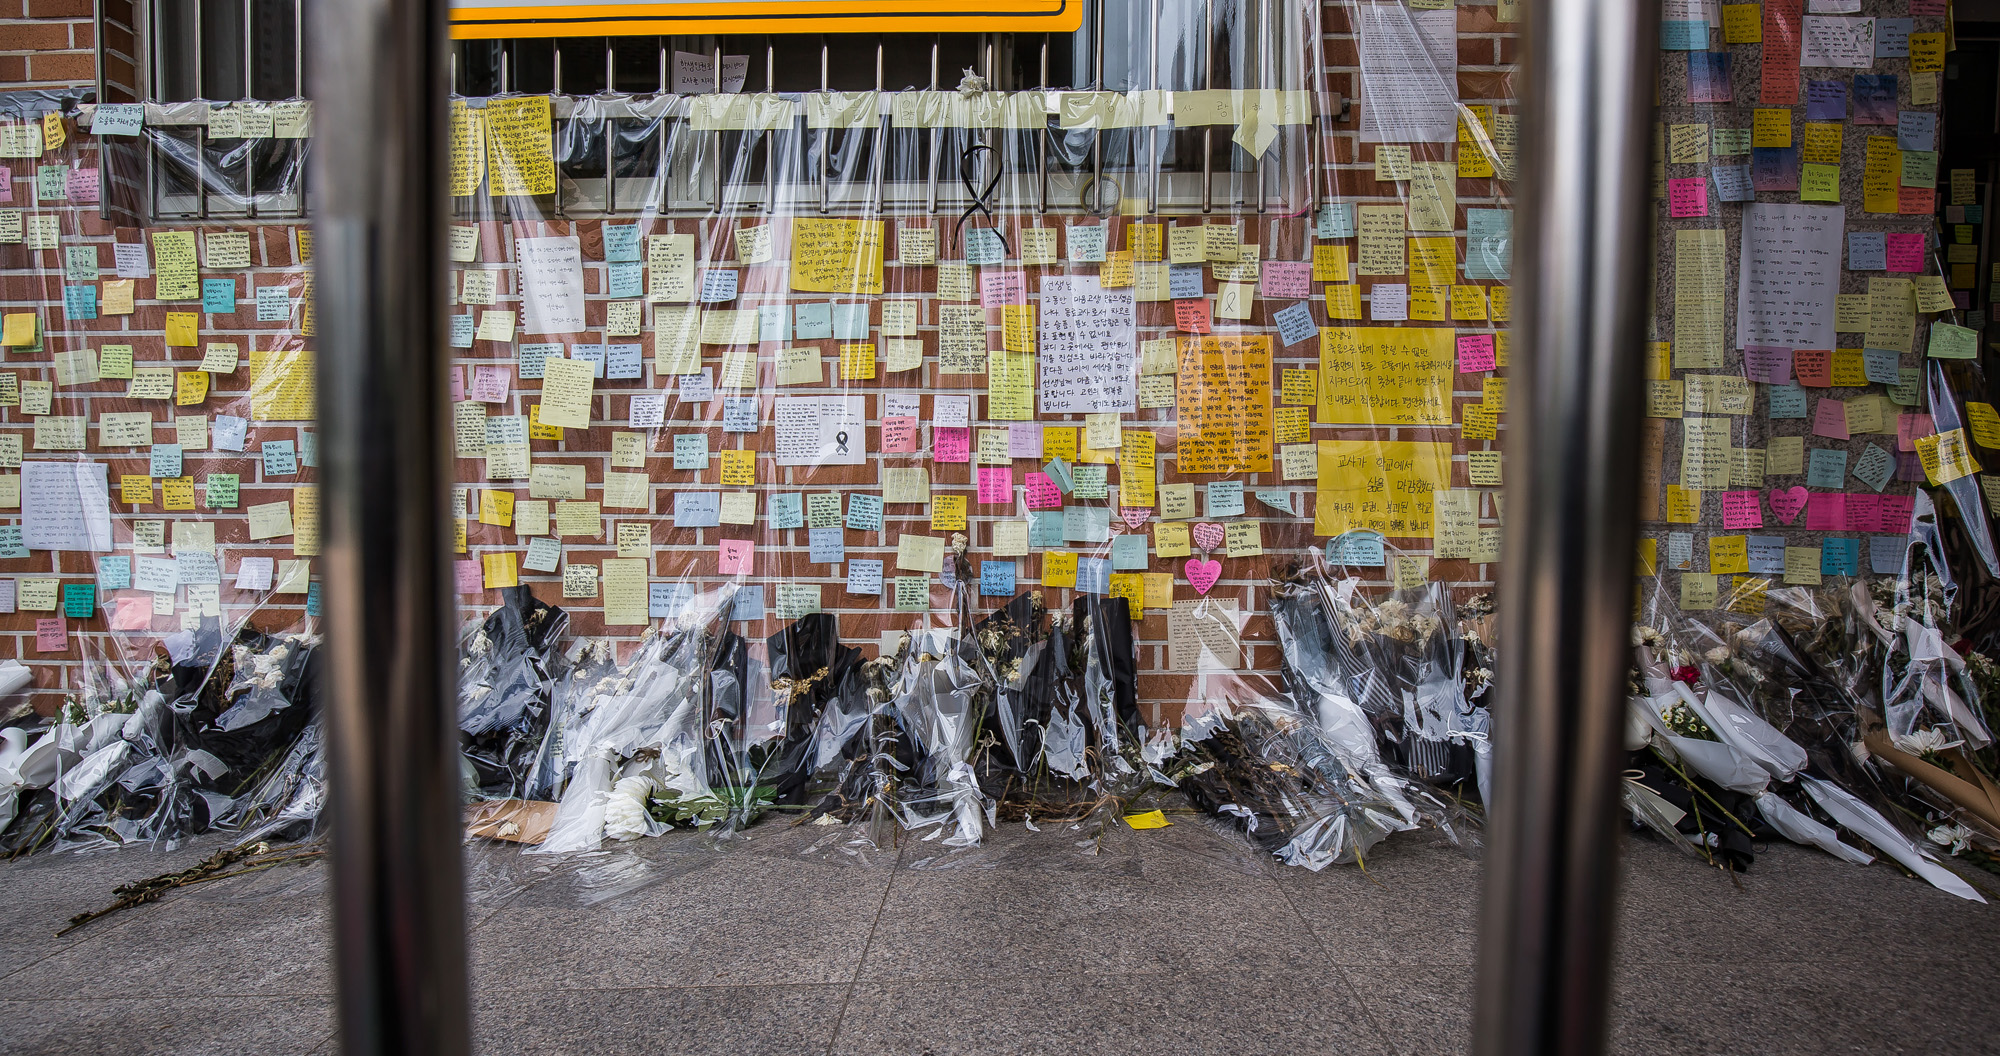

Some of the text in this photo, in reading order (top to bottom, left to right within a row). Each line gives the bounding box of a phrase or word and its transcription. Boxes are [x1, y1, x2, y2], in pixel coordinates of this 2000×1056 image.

[680, 59, 714, 72] 학생인권조
[1045, 281, 1076, 291] 선생님,
[1045, 295, 1067, 305] 그동안
[1074, 295, 1102, 304] 마음고생
[1111, 308, 1130, 316] 차오르
[1044, 321, 1049, 329] 는
[1124, 318, 1131, 326] 말
[1051, 332, 1075, 340] 표현할
[1080, 331, 1086, 339] 수
[1043, 343, 1056, 351] 부디
[1101, 341, 1130, 350] 편안하시
[1043, 354, 1054, 363] 기를
[1059, 354, 1085, 363] 진심으로
[1043, 366, 1063, 376] 꽃다운
[1093, 363, 1112, 372] 세상을
[1328, 360, 1354, 371] 그동안의
[1360, 361, 1376, 371] 모든
[1380, 360, 1411, 372] 고통에서
[1043, 379, 1072, 388] 선생님께
[1077, 376, 1090, 385] 마음
[1329, 375, 1371, 390] 지켜드리지
[1378, 375, 1396, 389] 못해
[1080, 388, 1099, 396] 고인의
[1103, 386, 1122, 395] 명복을
[1338, 455, 1413, 471] 교사가 학교에서
[1367, 476, 1435, 493] 삶을 마감했다
[1333, 502, 1354, 514] 무너진
[1386, 501, 1408, 514] 붕괴된
[1416, 501, 1432, 514] 학교
[1368, 520, 1385, 530] 고인의
[1410, 520, 1430, 531] 빕니다
